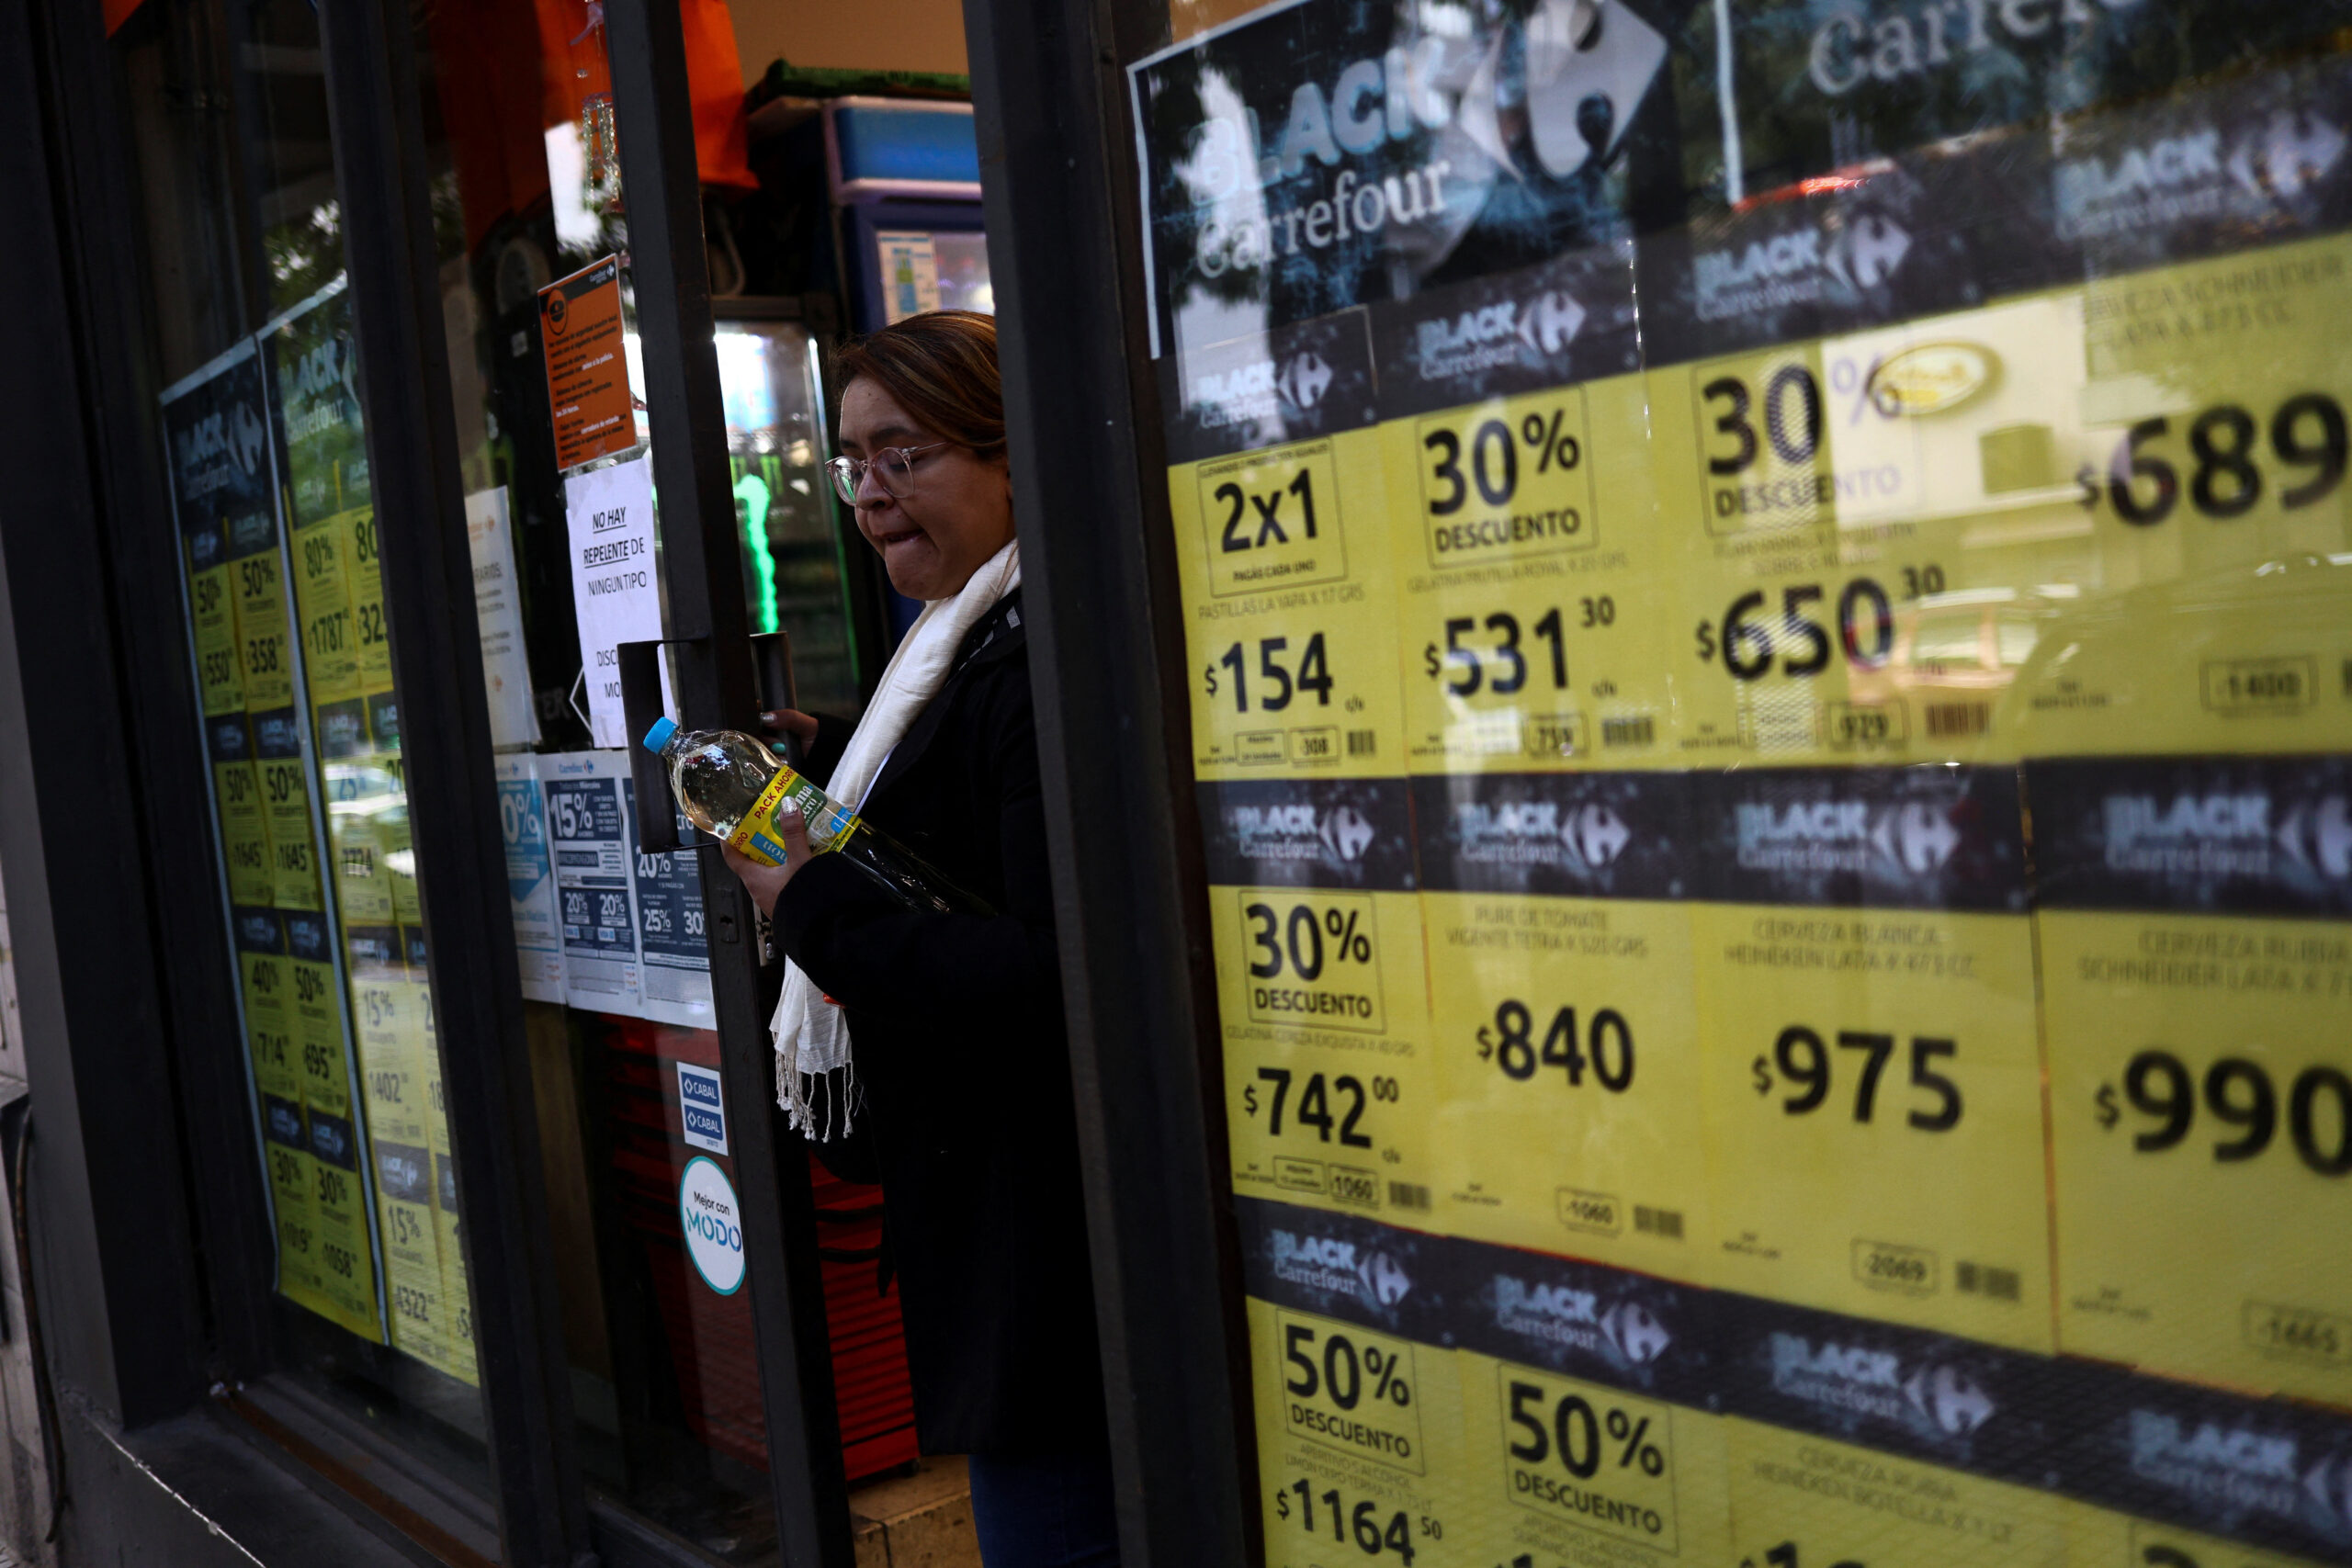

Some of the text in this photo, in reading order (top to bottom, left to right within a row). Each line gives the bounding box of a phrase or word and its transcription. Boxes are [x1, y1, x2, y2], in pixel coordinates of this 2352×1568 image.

[1195, 160, 1450, 278] Carrefour
[1416, 300, 1518, 360] BLACK
[1702, 363, 1906, 476] 30%
[1424, 409, 1580, 517] 30%
[2075, 393, 2350, 525] $689
[1214, 468, 1317, 553] 2x1
[1714, 465, 1903, 518] DESCUENTO
[593, 507, 627, 530] NO HAY
[1435, 508, 1580, 554] DESCUENTO
[583, 537, 645, 565] REPELENTE DE
[242, 558, 276, 598] 50%
[588, 571, 647, 597] NINGUN TIPO
[1695, 564, 1945, 682] $650 30
[597, 649, 618, 667] DISC
[1424, 595, 1617, 698] $531 30
[1204, 631, 1334, 713] $154
[266, 765, 303, 803] 50%
[754, 792, 777, 820] PACK
[550, 792, 594, 839] 15%
[1234, 805, 1317, 836] BLACK
[1458, 803, 1558, 837] BLACK
[1736, 802, 1869, 842] BLACK
[2104, 795, 2268, 840] BLACK
[565, 891, 588, 914] 20%
[599, 893, 625, 917] 20%
[643, 908, 673, 933] 25%
[1245, 902, 1372, 983] 30%
[294, 965, 325, 1003] 50%
[1255, 987, 1373, 1020] DESCUENTO
[1476, 998, 1635, 1095] $840
[694, 1081, 718, 1100] CABAL
[1752, 1025, 1962, 1134] $975
[696, 1114, 720, 1134] CABAL
[1242, 1066, 1373, 1150] $742
[2096, 1049, 2352, 1179] $990
[317, 1166, 348, 1206] 30%
[694, 1190, 730, 1216] Mejor con
[387, 1204, 422, 1245] 15%
[686, 1206, 742, 1253] MODO
[1272, 1229, 1356, 1269] BLACK
[1274, 1262, 1357, 1294] Carrefour
[1495, 1275, 1598, 1325] BLACK
[1286, 1324, 1410, 1411] 50%
[1769, 1331, 1899, 1386] BLACK
[1292, 1404, 1411, 1459] DESCUENTO
[1510, 1381, 1664, 1480] 50%
[1276, 1477, 1443, 1568] $1164 50
[1515, 1469, 1663, 1536] DESCUENTO
